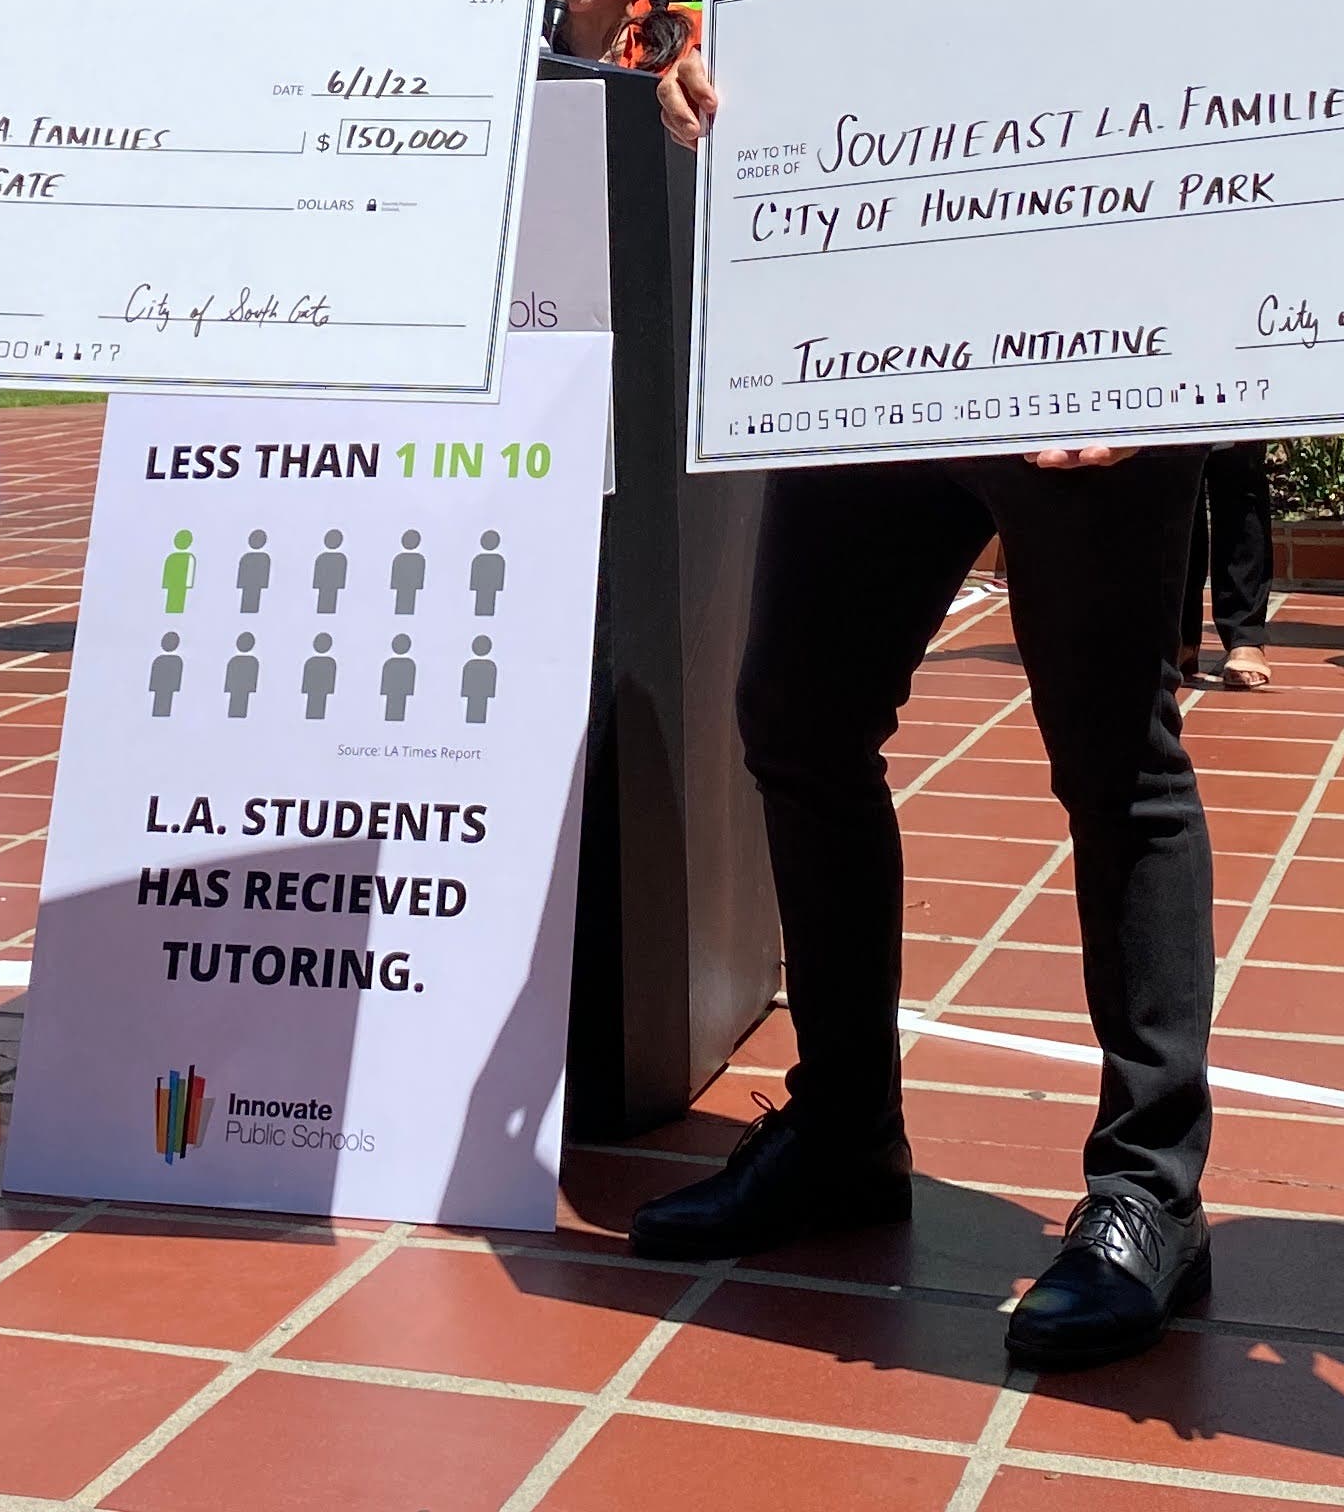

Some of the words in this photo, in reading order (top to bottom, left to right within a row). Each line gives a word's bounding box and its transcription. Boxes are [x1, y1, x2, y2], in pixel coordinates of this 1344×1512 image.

[272, 84, 304, 97] DATE
[326, 66, 431, 100] 6/1/22
[30, 115, 172, 150] FAMILIES
[316, 134, 331, 153] $
[345, 124, 469, 156] 150,000
[817, 110, 1084, 174] SOUTHEAST
[1095, 103, 1165, 138] L.A.
[737, 148, 759, 163] PAY
[763, 146, 779, 159] TO
[784, 143, 807, 156] THE
[737, 164, 780, 180] ORDER
[783, 162, 801, 174] OF
[297, 199, 354, 211] DOLLARS
[752, 202, 840, 253] CITY
[856, 197, 898, 232] OF
[921, 180, 1155, 227] HUNTINGTON
[1179, 172, 1275, 211] PARK
[125, 283, 170, 333] City
[190, 295, 215, 338] of
[221, 287, 279, 328] South
[1258, 294, 1318, 349] City
[729, 375, 774, 389] MEMO
[793, 337, 974, 382] TUTORING
[992, 325, 1169, 365] INITIATIVE
[145, 444, 241, 480] LESS
[255, 443, 380, 479] THAN
[395, 442, 416, 478] 1
[433, 442, 484, 478] IN
[500, 442, 551, 479] 10
[337, 744, 381, 757] Source:
[385, 745, 400, 757] LA
[403, 746, 437, 759] Times
[441, 747, 481, 762] Report
[146, 795, 227, 835] L.A.
[242, 797, 488, 843] STUDENTS
[137, 867, 231, 909] HAS
[244, 870, 467, 918] RECIEVED
[163, 941, 425, 993] TUTORING.
[228, 1093, 333, 1120] Innovate
[225, 1120, 286, 1146] Public
[292, 1124, 375, 1152] Schools
